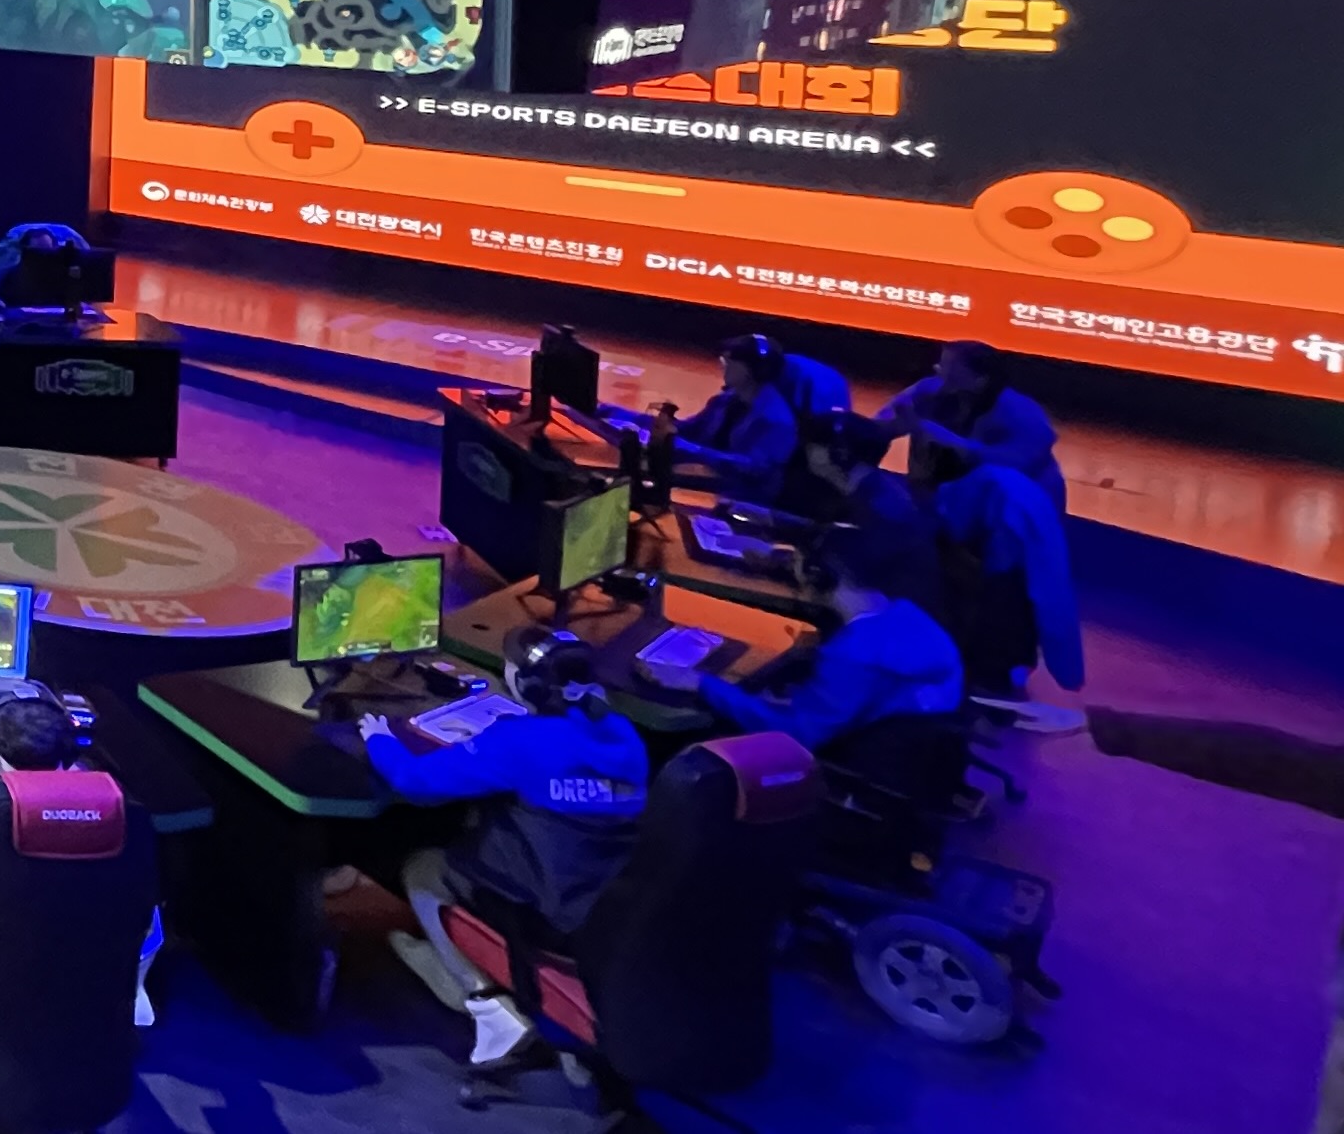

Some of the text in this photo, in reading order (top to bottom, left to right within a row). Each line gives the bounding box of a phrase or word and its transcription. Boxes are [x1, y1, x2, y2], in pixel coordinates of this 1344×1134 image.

[417, 97, 881, 154] E-SPORTS DAEJEON ARENA
[335, 208, 442, 238] 대전광역시
[1009, 302, 1280, 355] 한국장애인고용공단
[75, 596, 208, 624] 대전
